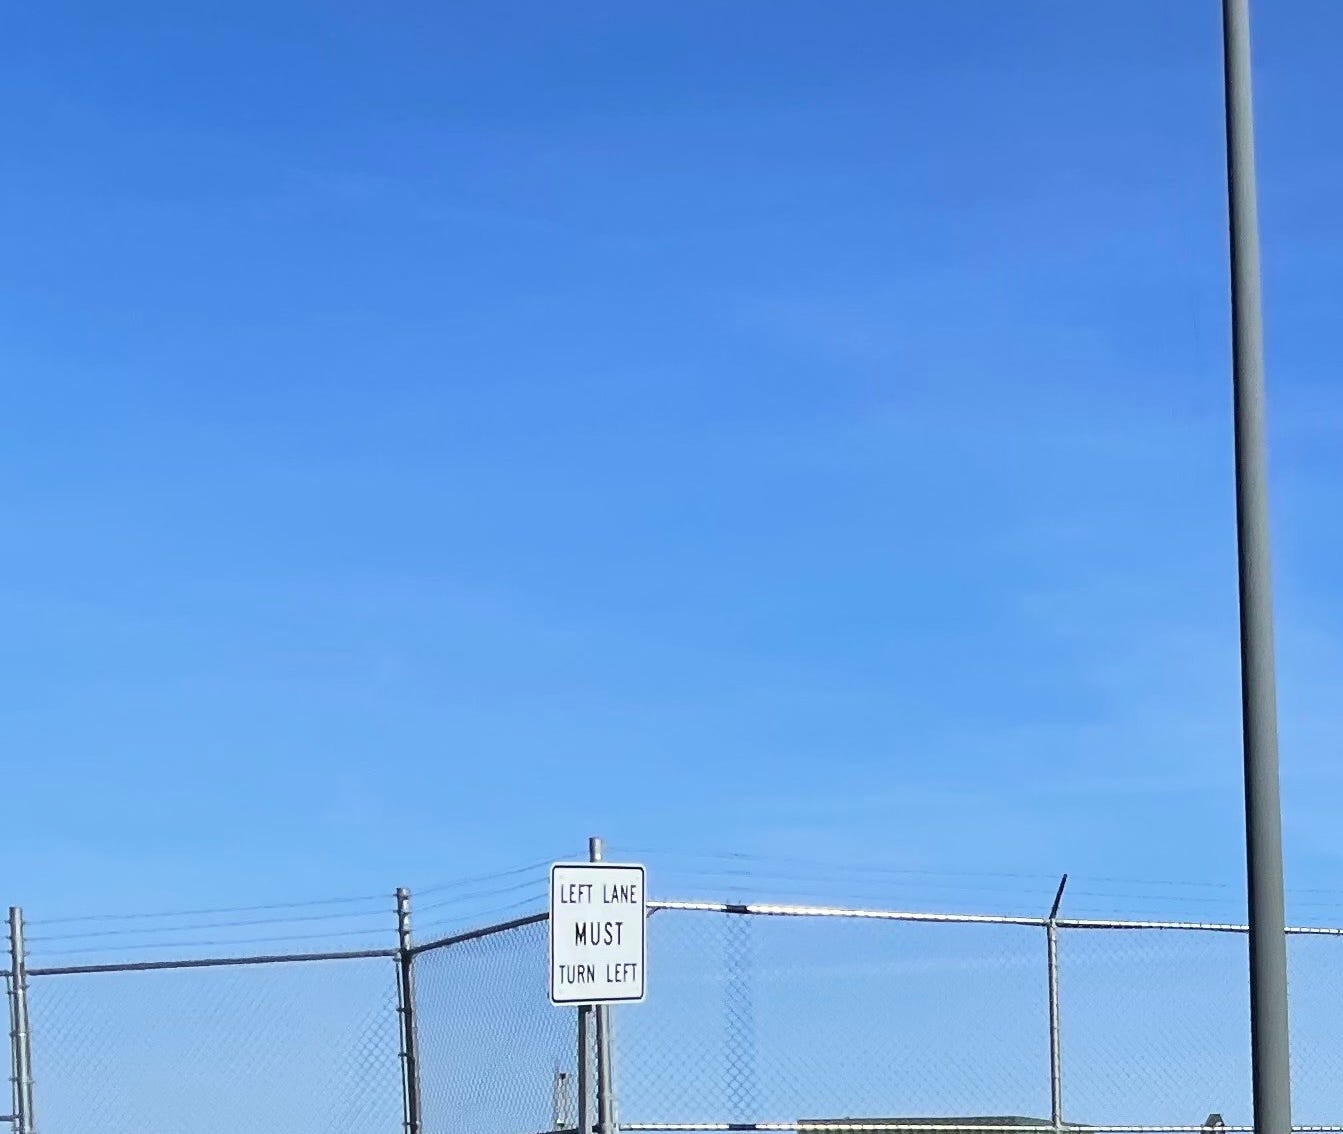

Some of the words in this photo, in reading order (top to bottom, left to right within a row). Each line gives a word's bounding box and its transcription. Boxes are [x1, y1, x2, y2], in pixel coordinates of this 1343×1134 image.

[561, 884, 592, 903] LEFT
[603, 885, 637, 903] LANE
[575, 921, 623, 946] MUST
[560, 964, 595, 984] TURN
[607, 963, 637, 982] LEFT
